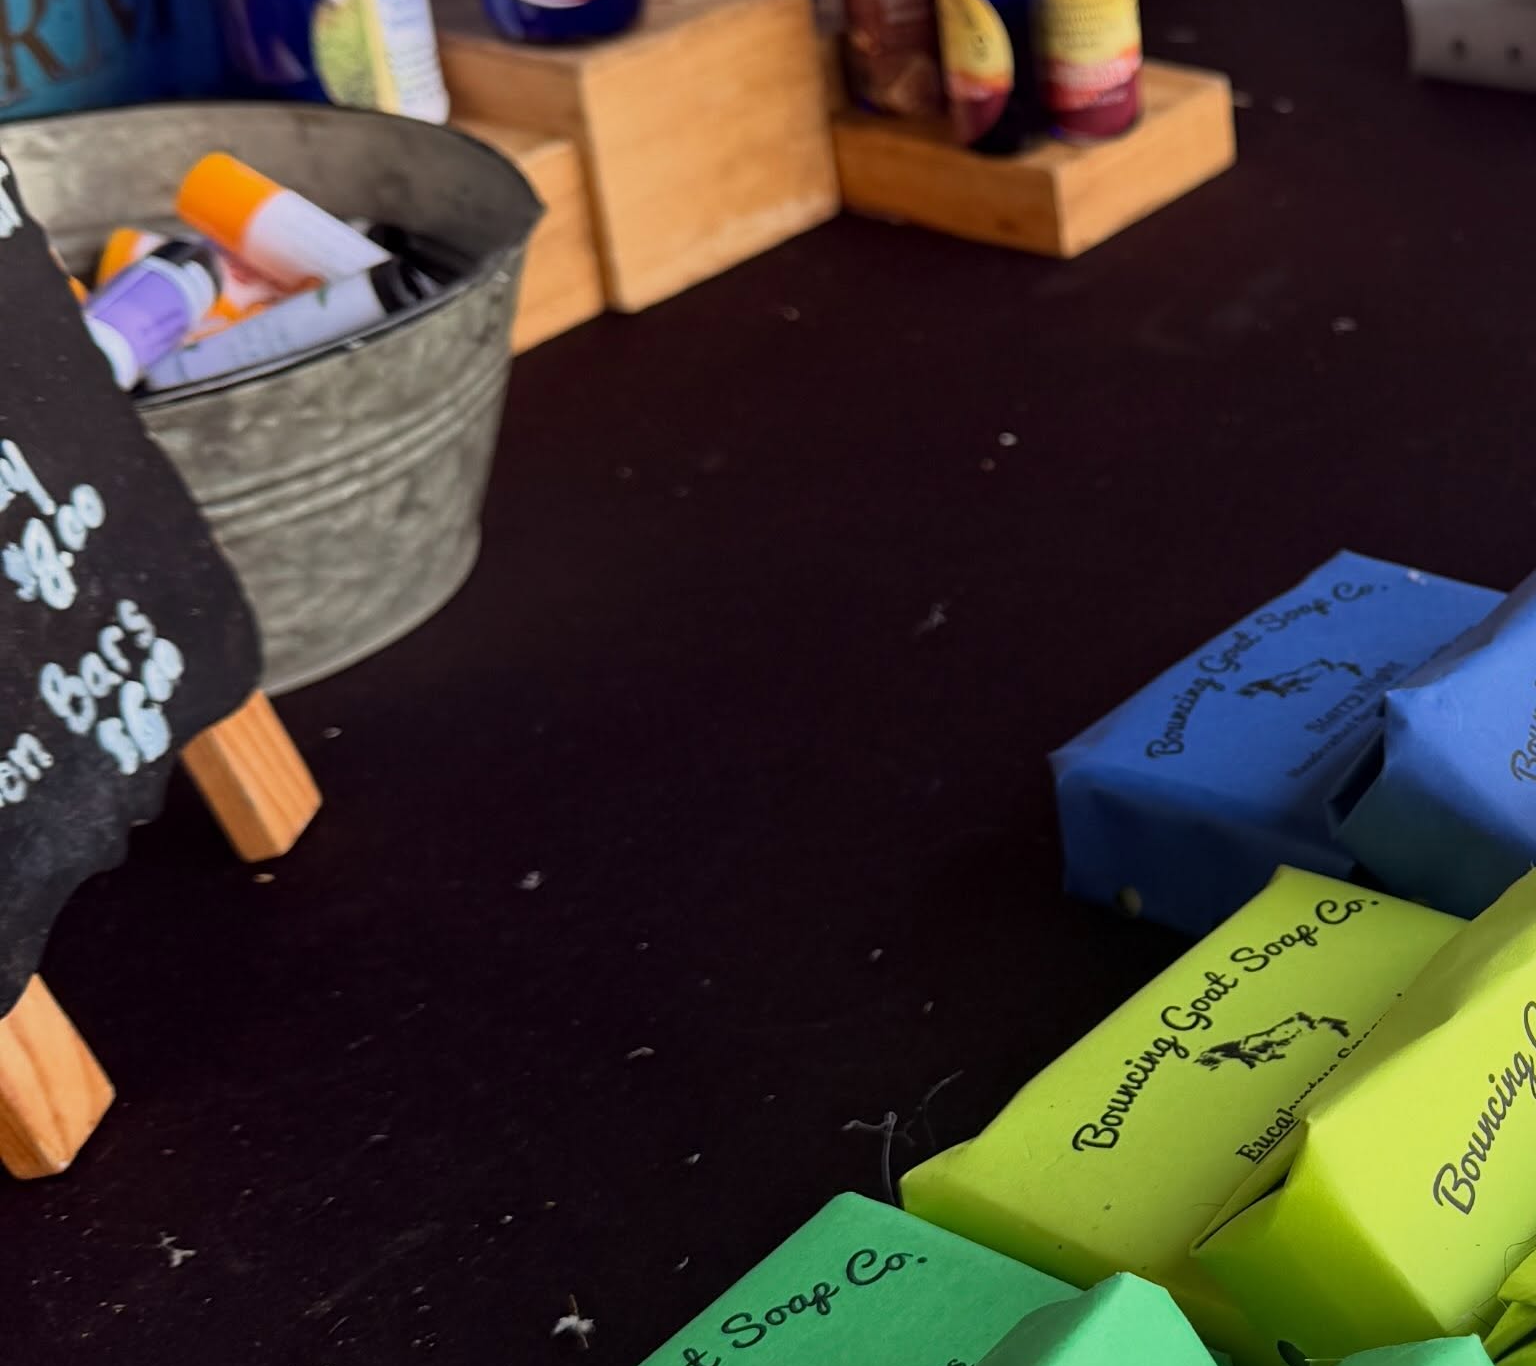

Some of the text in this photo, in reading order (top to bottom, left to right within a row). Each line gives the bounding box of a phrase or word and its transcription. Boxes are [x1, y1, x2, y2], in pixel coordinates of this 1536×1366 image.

[38, 598, 155, 735] Bars
[1146, 664, 1224, 760] Bouncing
[1199, 625, 1262, 674] Goat
[1255, 597, 1332, 632] Soap
[1071, 898, 1380, 1152] Bouncing Goat Soap Co.
[720, 1278, 841, 1348] Soap
[845, 1247, 927, 1287] Co.
